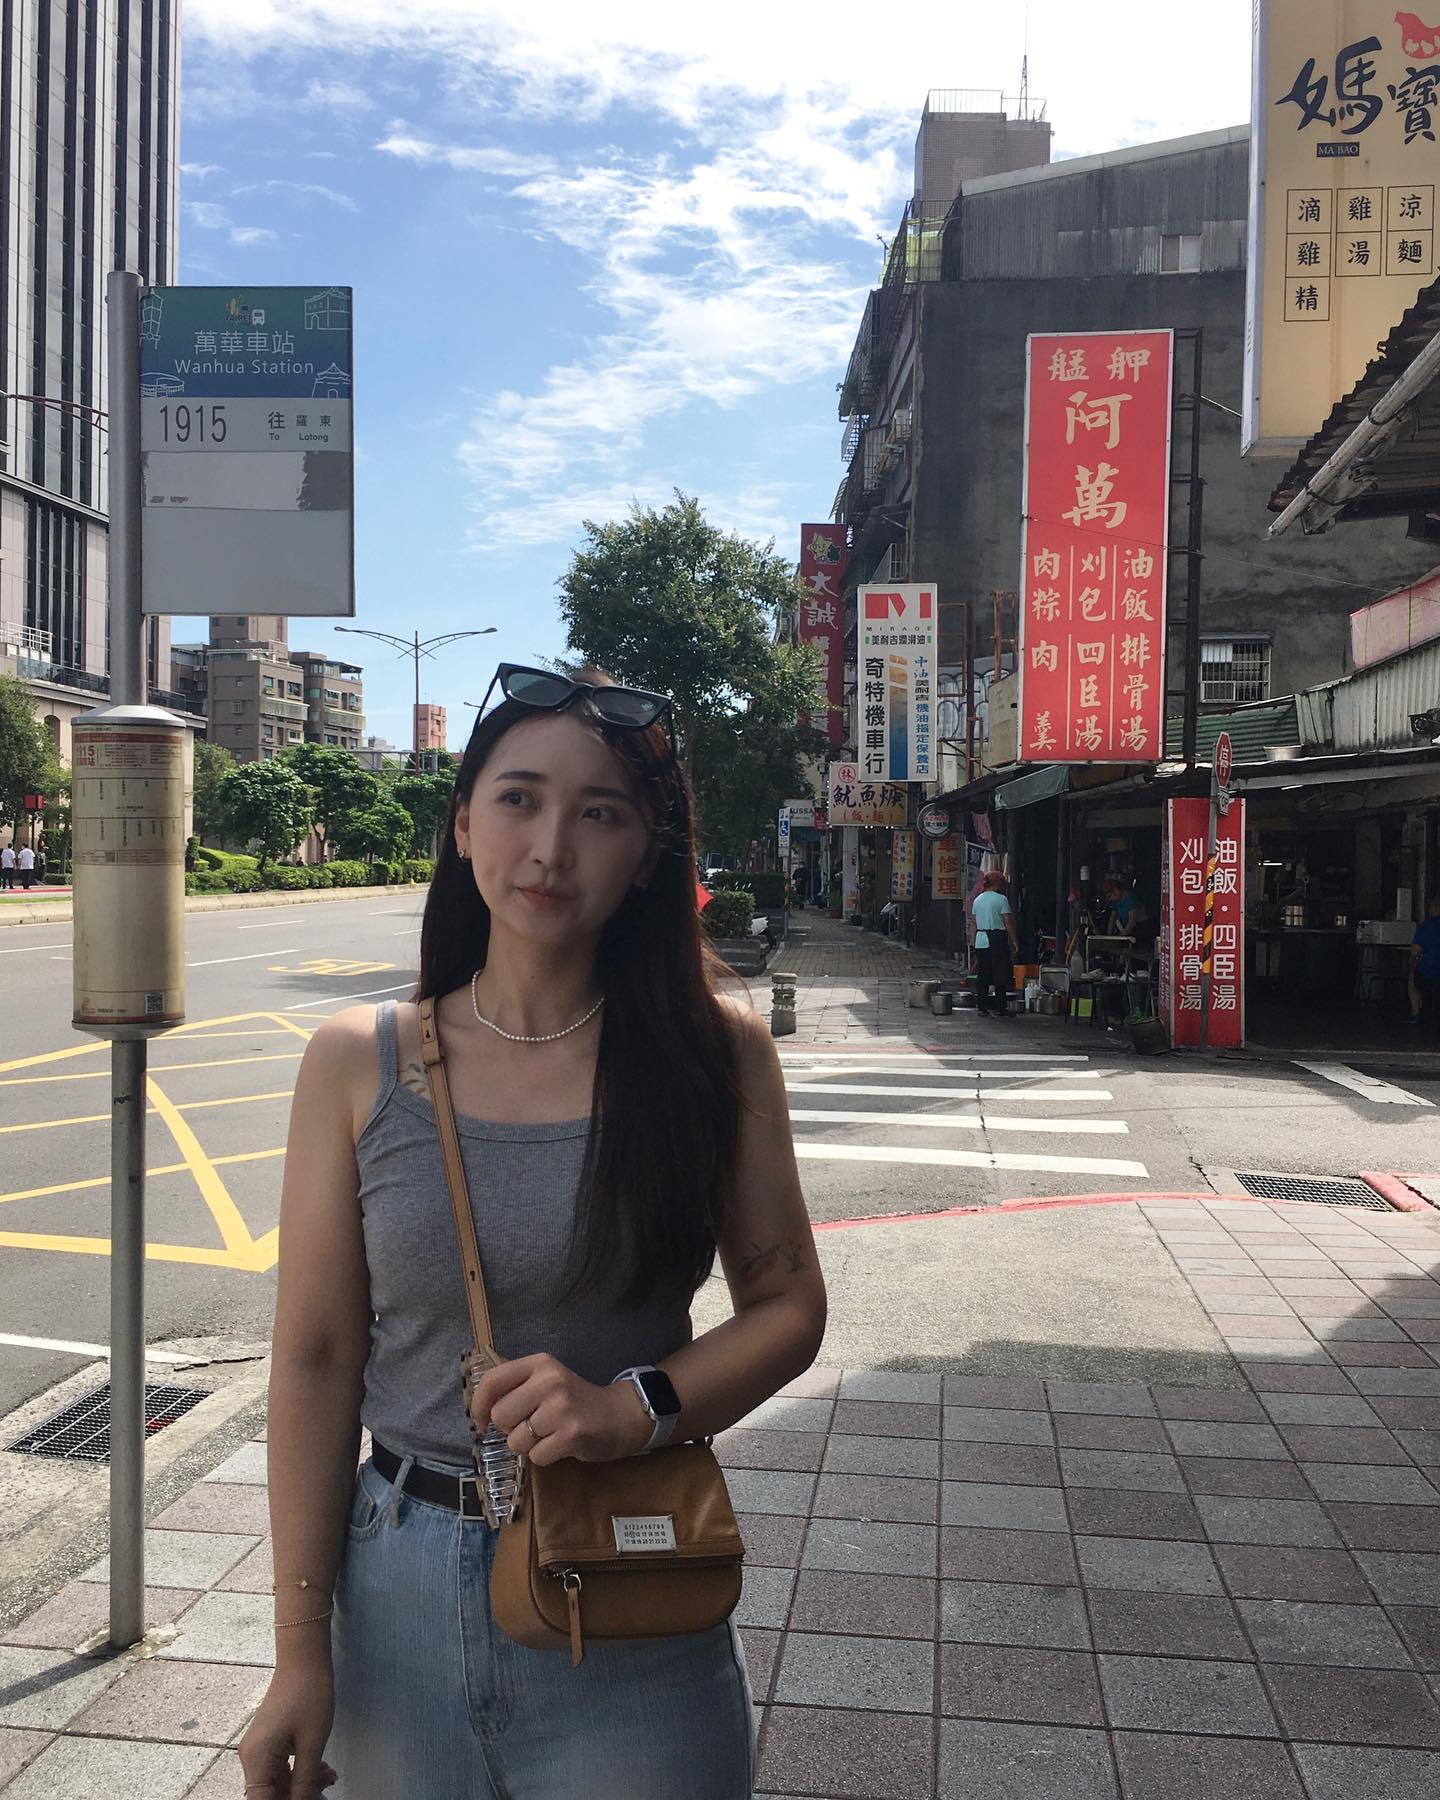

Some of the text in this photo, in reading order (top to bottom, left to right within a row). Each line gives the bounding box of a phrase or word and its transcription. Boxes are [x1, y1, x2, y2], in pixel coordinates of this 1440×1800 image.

[1274, 36, 1440, 144] 媽寶
[1317, 143, 1359, 155] MA BAO
[1295, 198, 1321, 311] 滴雞精
[1348, 196, 1372, 266] 雞湯
[1398, 194, 1422, 264] 涼麵
[174, 359, 314, 374] Wanhua Station
[194, 330, 295, 355] 萬華車站
[1048, 347, 1151, 382] 艋舺
[160, 405, 227, 443] 1915
[268, 412, 331, 429] 往 羅東
[269, 433, 280, 441] To
[1062, 391, 1132, 529] 阿萬
[1032, 548, 1060, 622] 肉粽
[1078, 546, 1107, 622] 刈包
[1121, 548, 1154, 622] 油飯
[865, 657, 885, 774] 奇特機車行
[1074, 641, 1104, 751] 四臣湯
[1120, 633, 1151, 751] 排骨湯
[841, 769, 853, 780] 林
